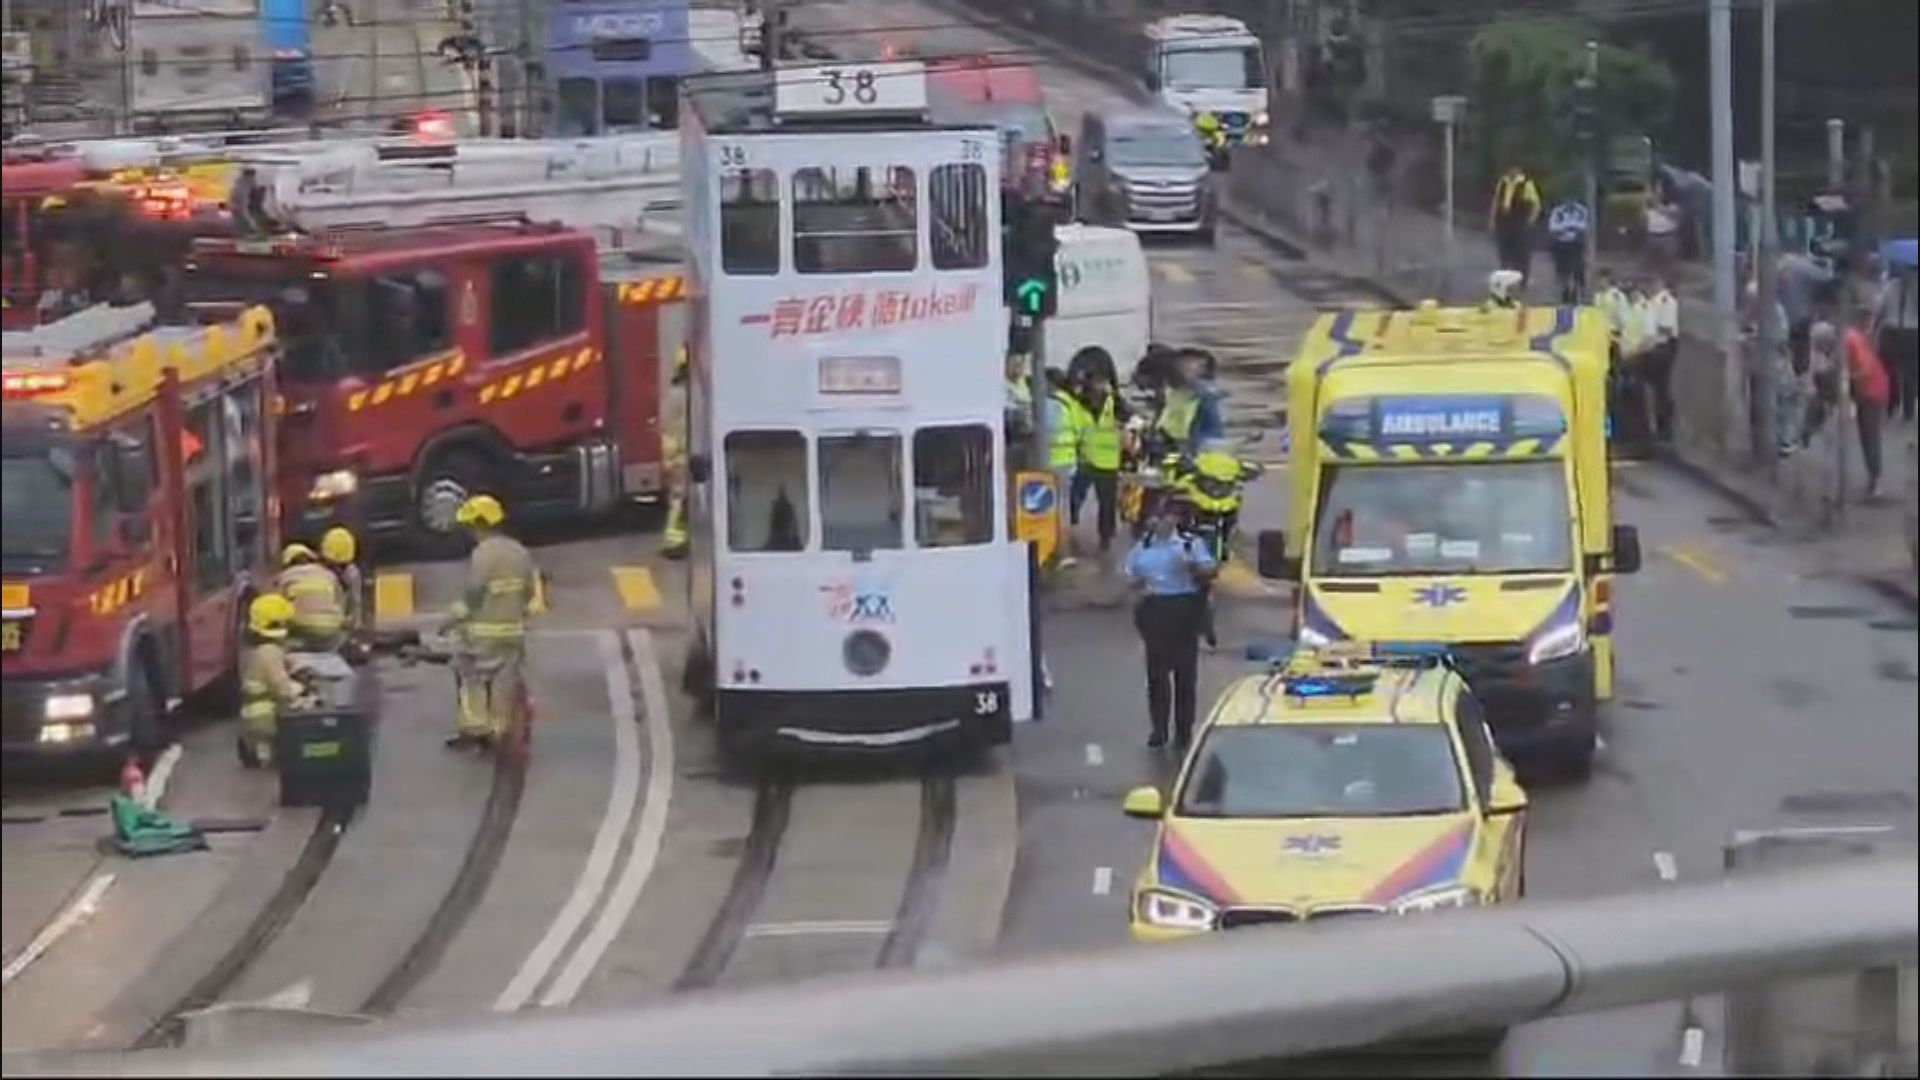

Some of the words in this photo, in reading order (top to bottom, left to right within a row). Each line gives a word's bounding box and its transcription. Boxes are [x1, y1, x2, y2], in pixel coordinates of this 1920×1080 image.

[821, 69, 877, 104] 38
[719, 145, 745, 166] 38
[960, 139, 983, 160] 38
[1382, 409, 1500, 435] AMBULANCE
[975, 692, 998, 715] 38
